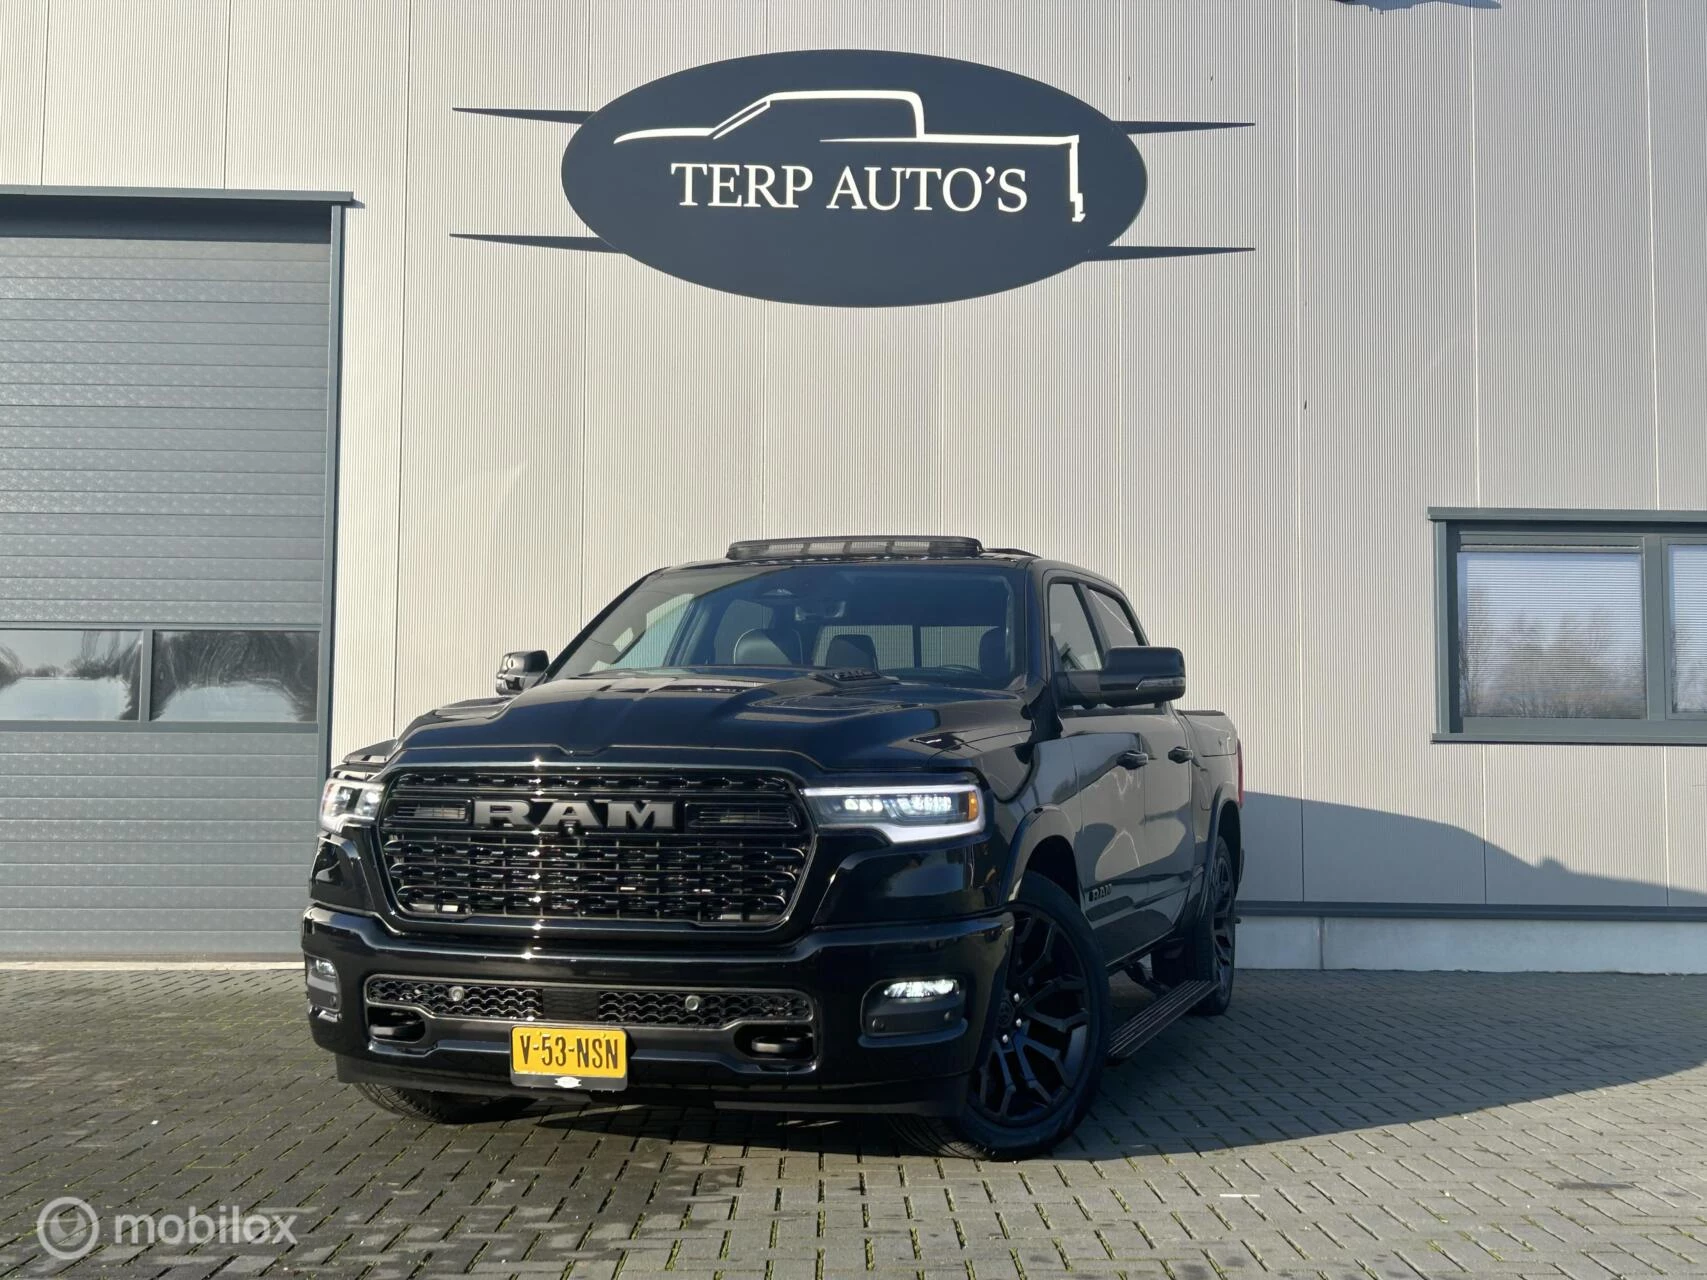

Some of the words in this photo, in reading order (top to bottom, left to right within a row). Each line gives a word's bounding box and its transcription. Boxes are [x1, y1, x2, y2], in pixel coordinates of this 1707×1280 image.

[670, 162, 814, 209] TERP
[826, 165, 1028, 213] AUTO'S
[473, 799, 676, 830] RAM
[520, 1035, 618, 1069] V-53-NSN
